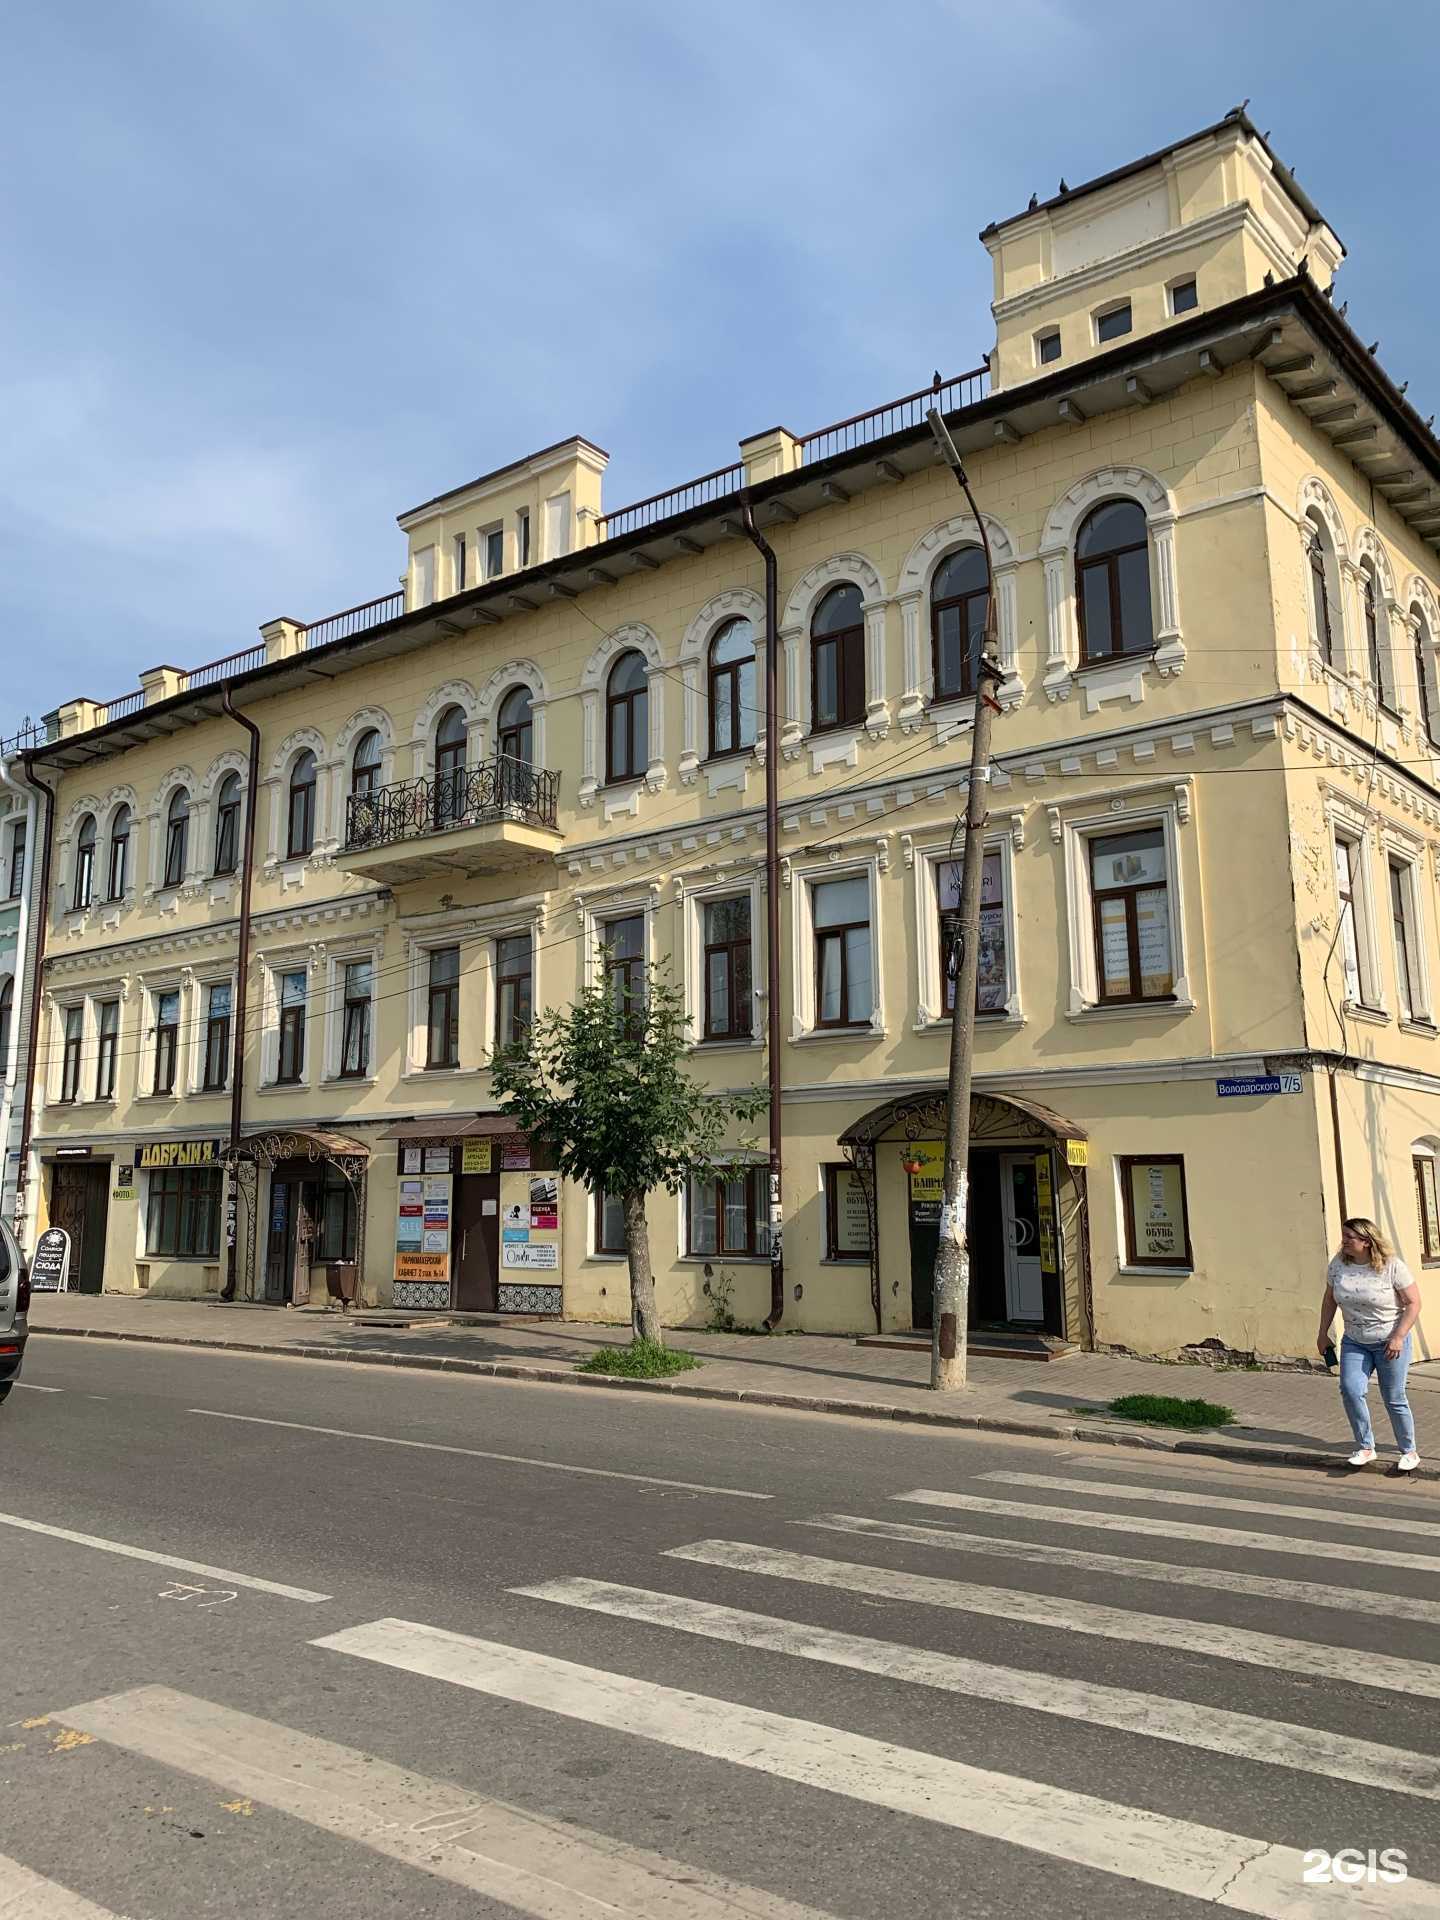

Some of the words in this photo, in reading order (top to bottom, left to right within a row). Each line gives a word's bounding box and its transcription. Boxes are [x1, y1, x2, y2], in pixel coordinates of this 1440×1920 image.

[1219, 1082, 1280, 1094] Володарского
[1282, 1076, 1300, 1092] 7/5
[140, 1141, 214, 1167] ДОБРЫНЯ
[1068, 1147, 1087, 1163] ОБУВЬ
[1146, 1228, 1173, 1237] ОБУВЬ
[35, 1262, 61, 1270] СЮДА
